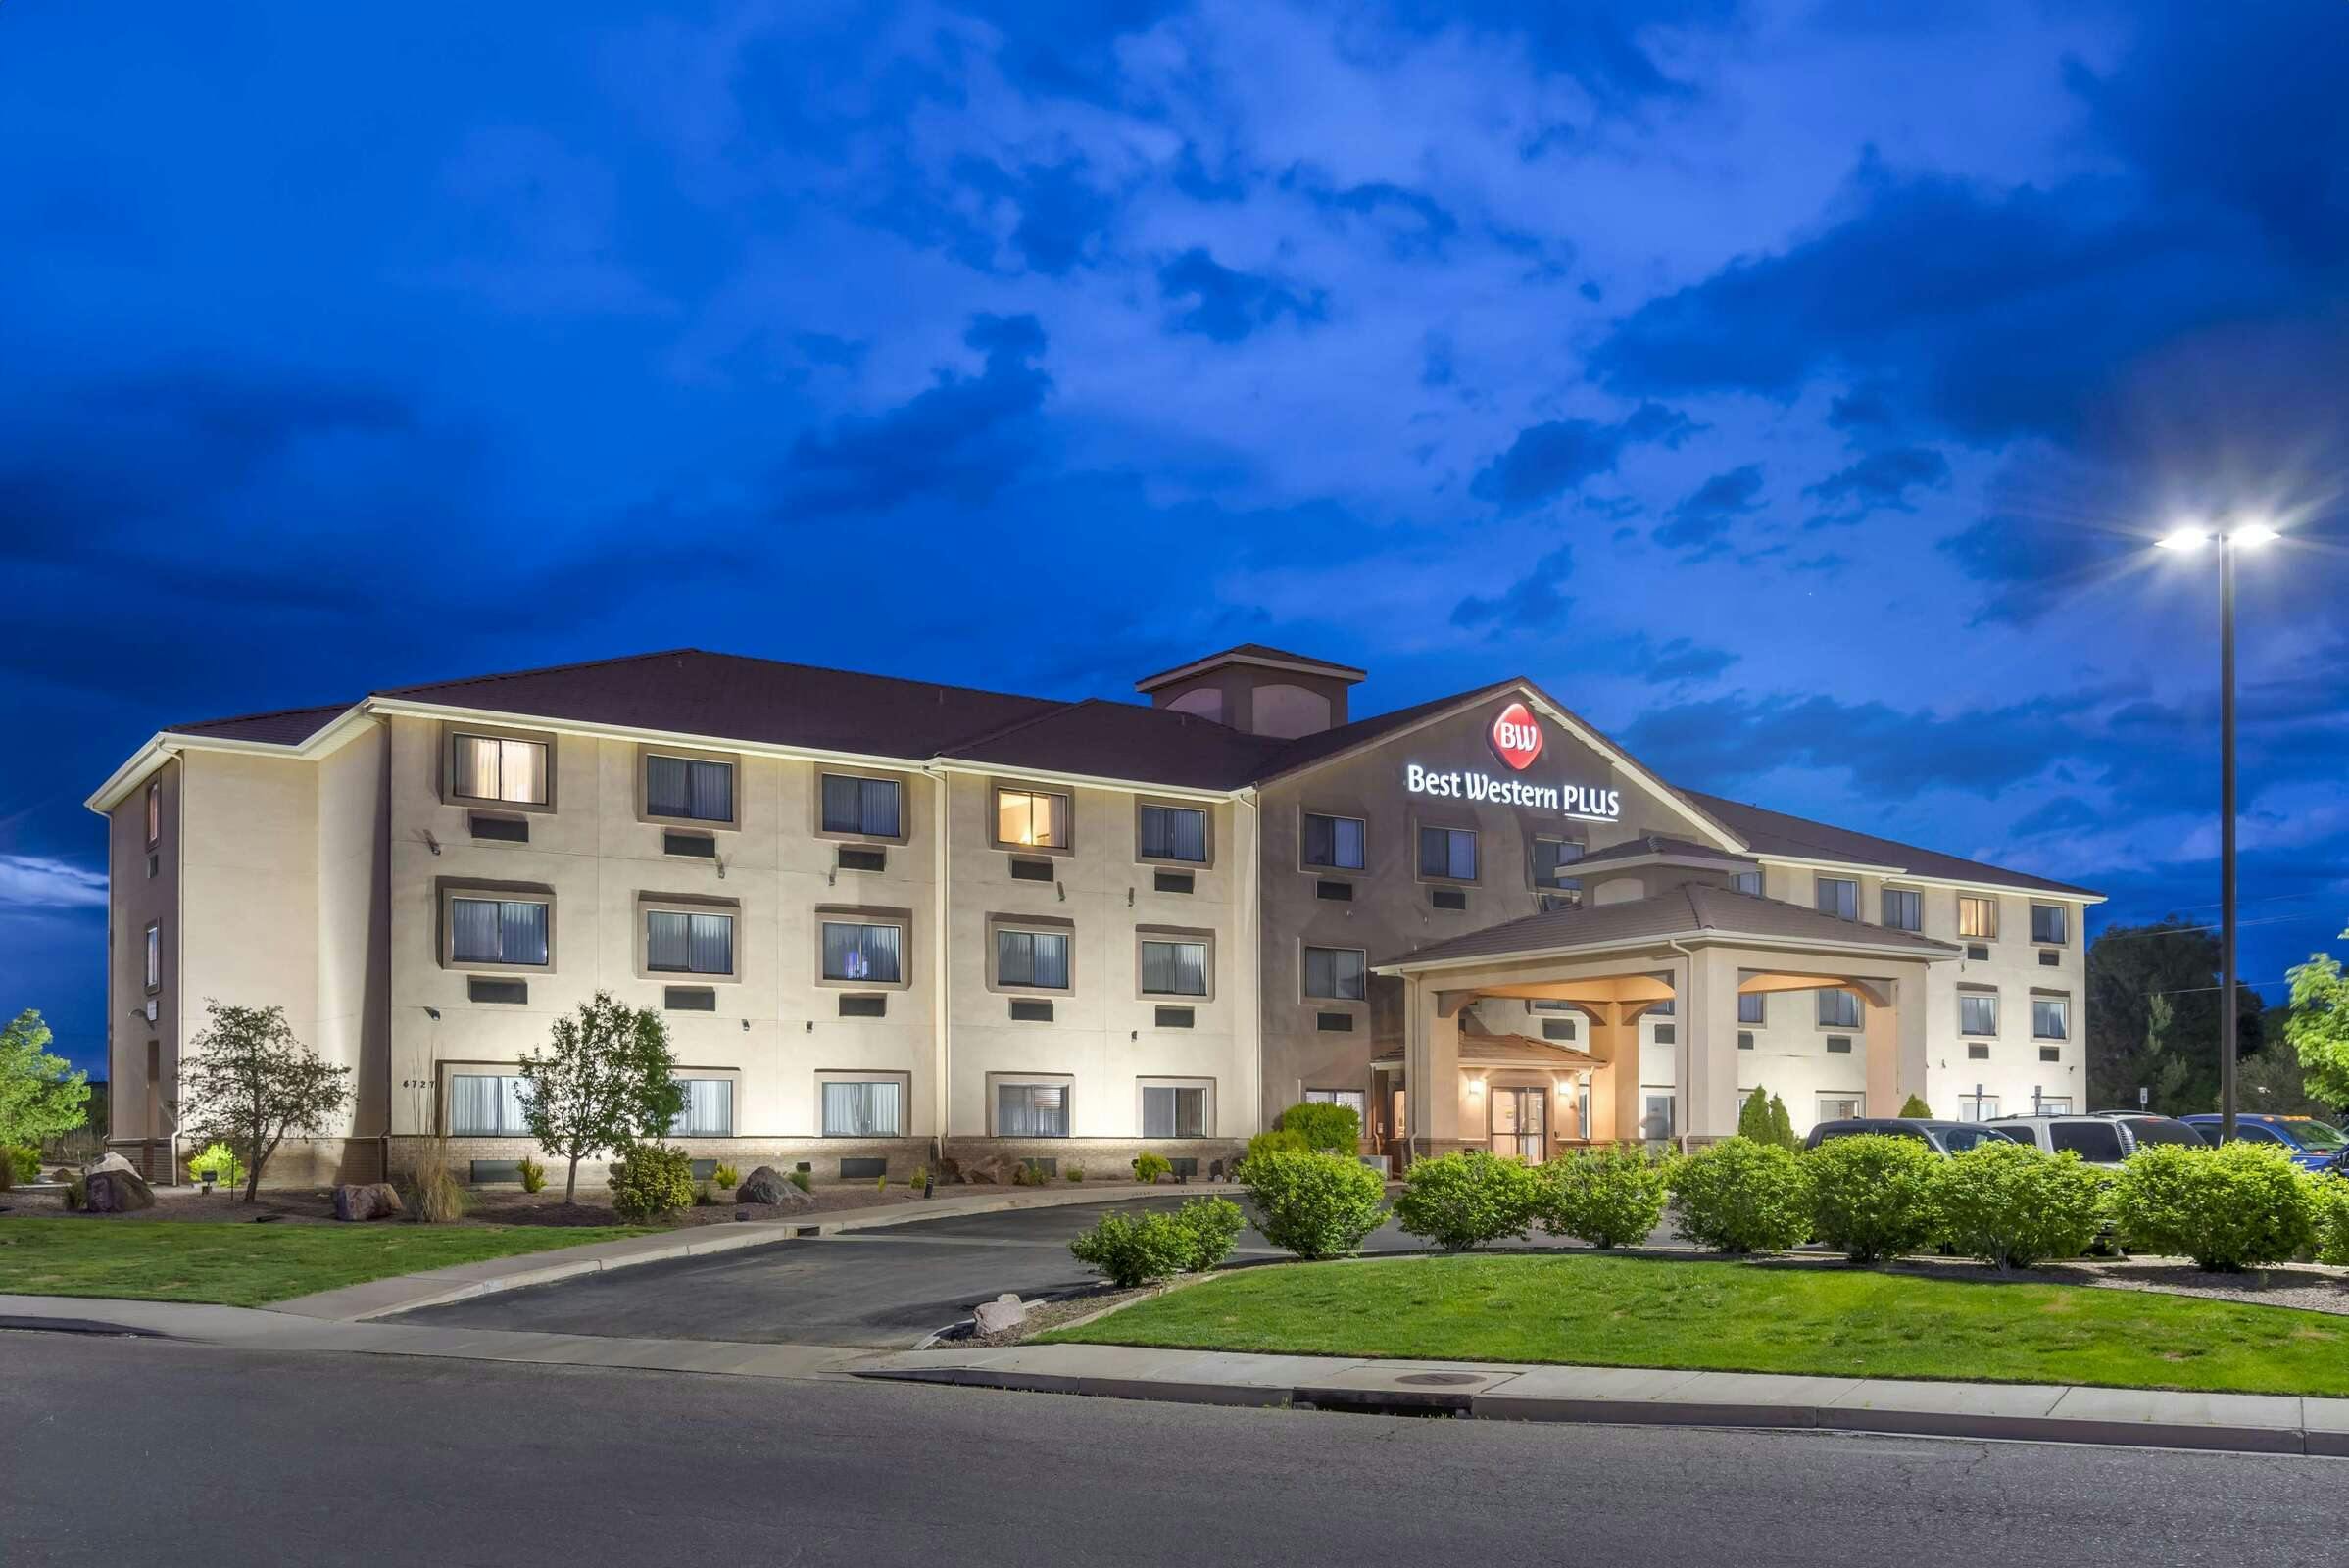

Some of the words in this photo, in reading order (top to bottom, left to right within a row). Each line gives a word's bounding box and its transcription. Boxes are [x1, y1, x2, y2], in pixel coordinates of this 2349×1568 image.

[1500, 722, 1537, 752] BW
[1407, 764, 1461, 798] Best
[1465, 772, 1558, 809] Western
[1564, 785, 1619, 816] PLUS
